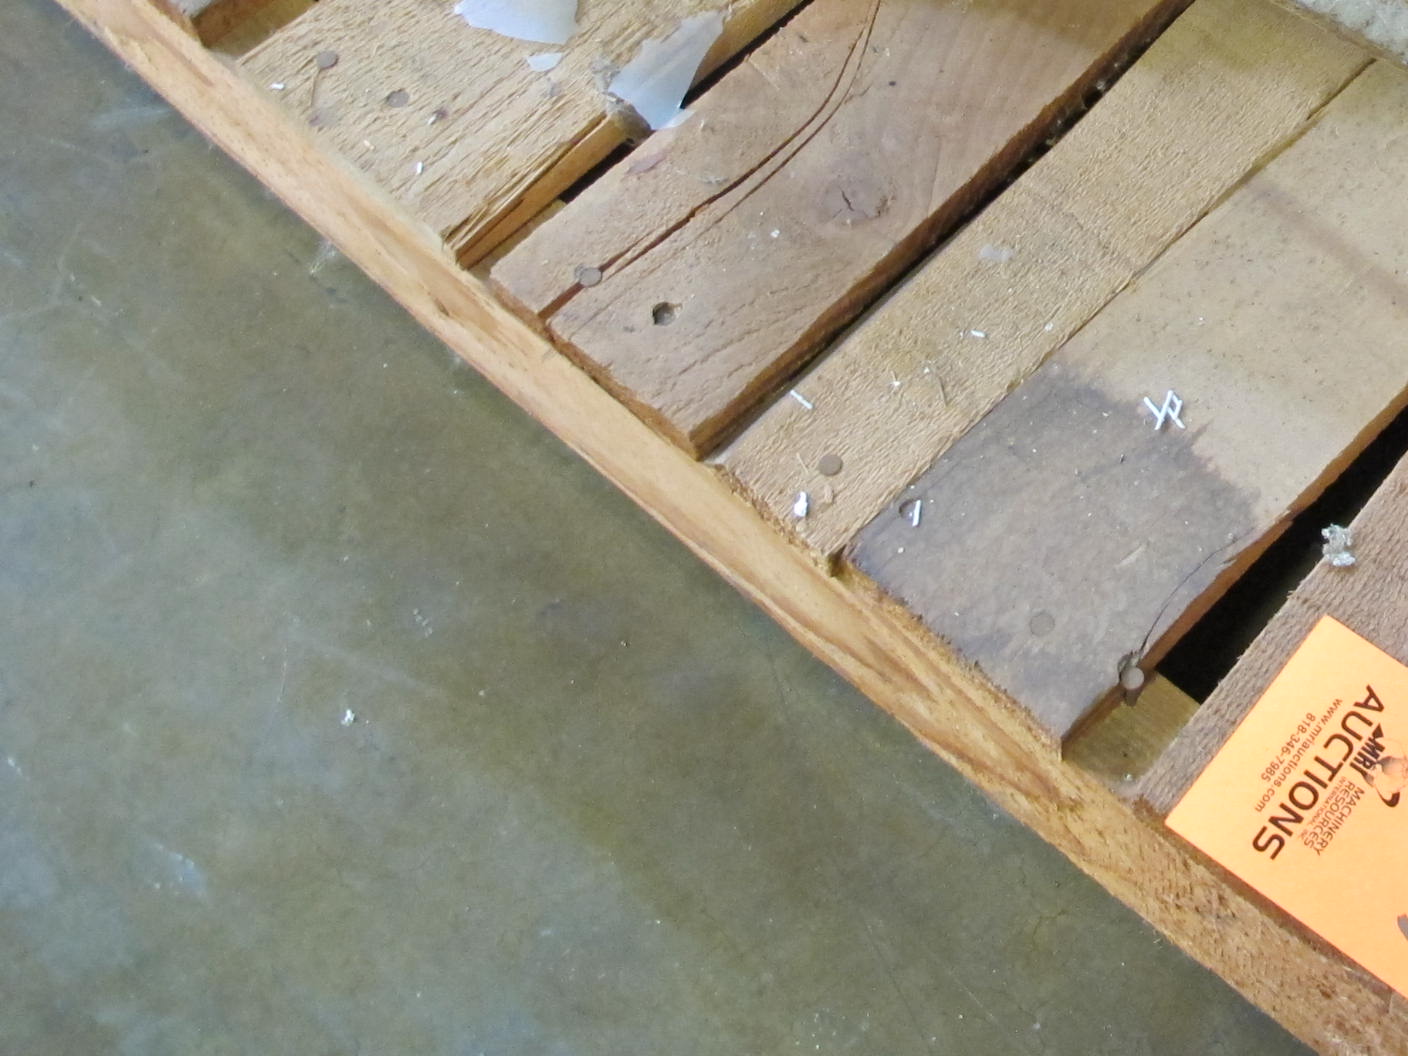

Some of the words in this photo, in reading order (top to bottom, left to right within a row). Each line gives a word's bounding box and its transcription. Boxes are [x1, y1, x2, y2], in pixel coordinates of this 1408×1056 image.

[1252, 684, 1385, 860] AUCTIONS
[1254, 697, 1343, 813] www.mriauctions.com
[1260, 712, 1317, 783] 818-346-7985
[1303, 781, 1356, 848] RESOURCES
[1314, 786, 1365, 856] MACHINERY
